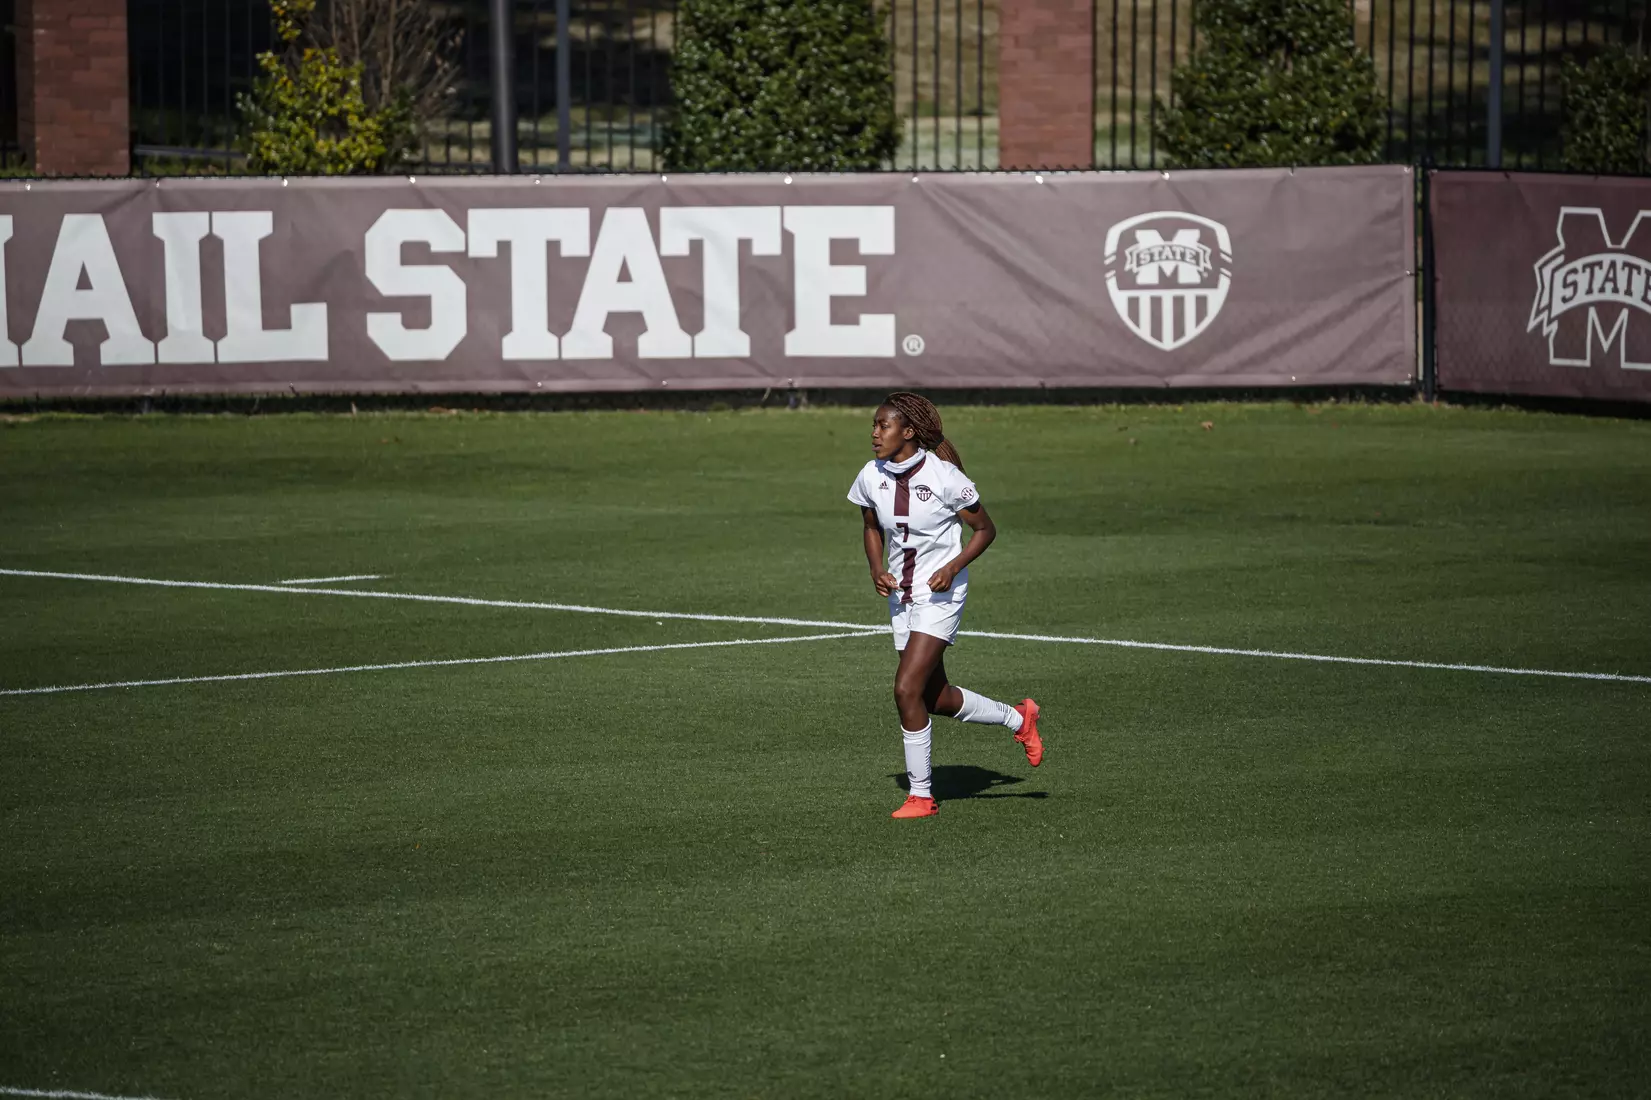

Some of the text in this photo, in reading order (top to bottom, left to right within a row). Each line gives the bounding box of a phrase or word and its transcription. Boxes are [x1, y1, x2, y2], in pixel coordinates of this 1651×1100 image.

[1139, 245, 1197, 265] STATE
[0, 211, 328, 366] AIL
[365, 205, 896, 361] STATE
[895, 522, 909, 543] 7
